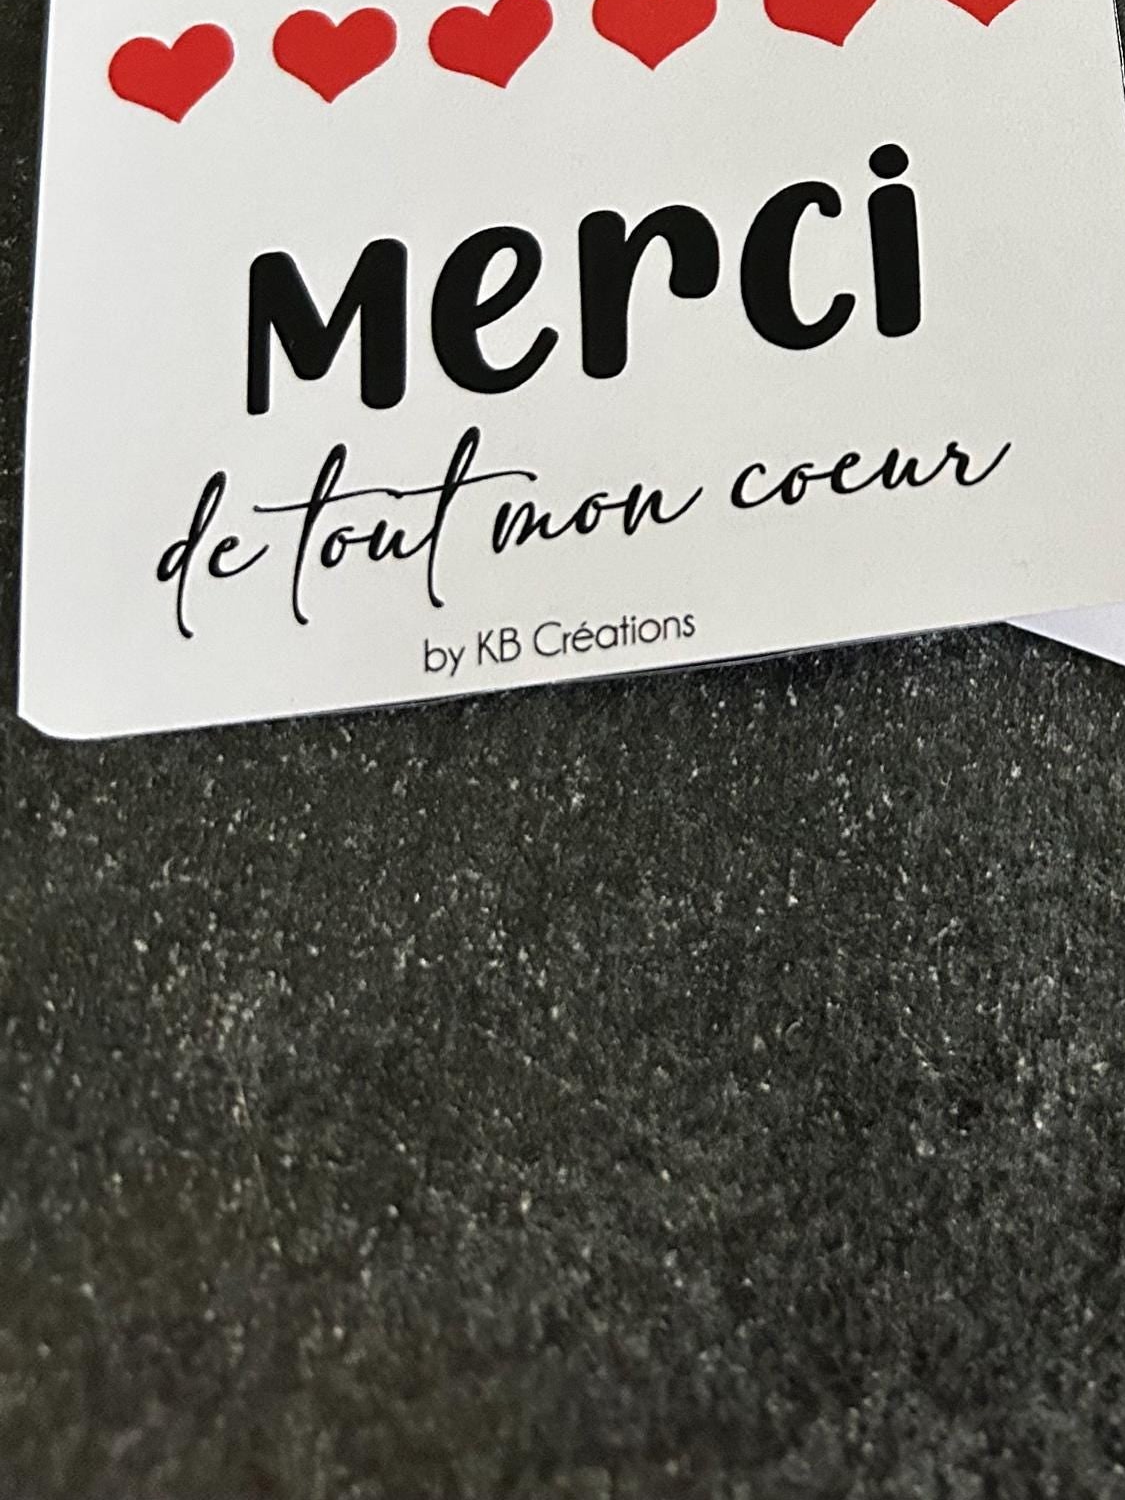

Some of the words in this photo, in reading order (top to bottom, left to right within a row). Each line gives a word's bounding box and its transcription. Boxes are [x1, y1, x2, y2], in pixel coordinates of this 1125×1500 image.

[245, 142, 922, 417] Merci
[155, 470, 270, 640] de
[251, 425, 539, 627] tout
[490, 482, 704, 555] mon
[729, 440, 1013, 510] coeur
[422, 637, 467, 678] by
[476, 629, 522, 666] KB
[531, 612, 697, 658] Créations
